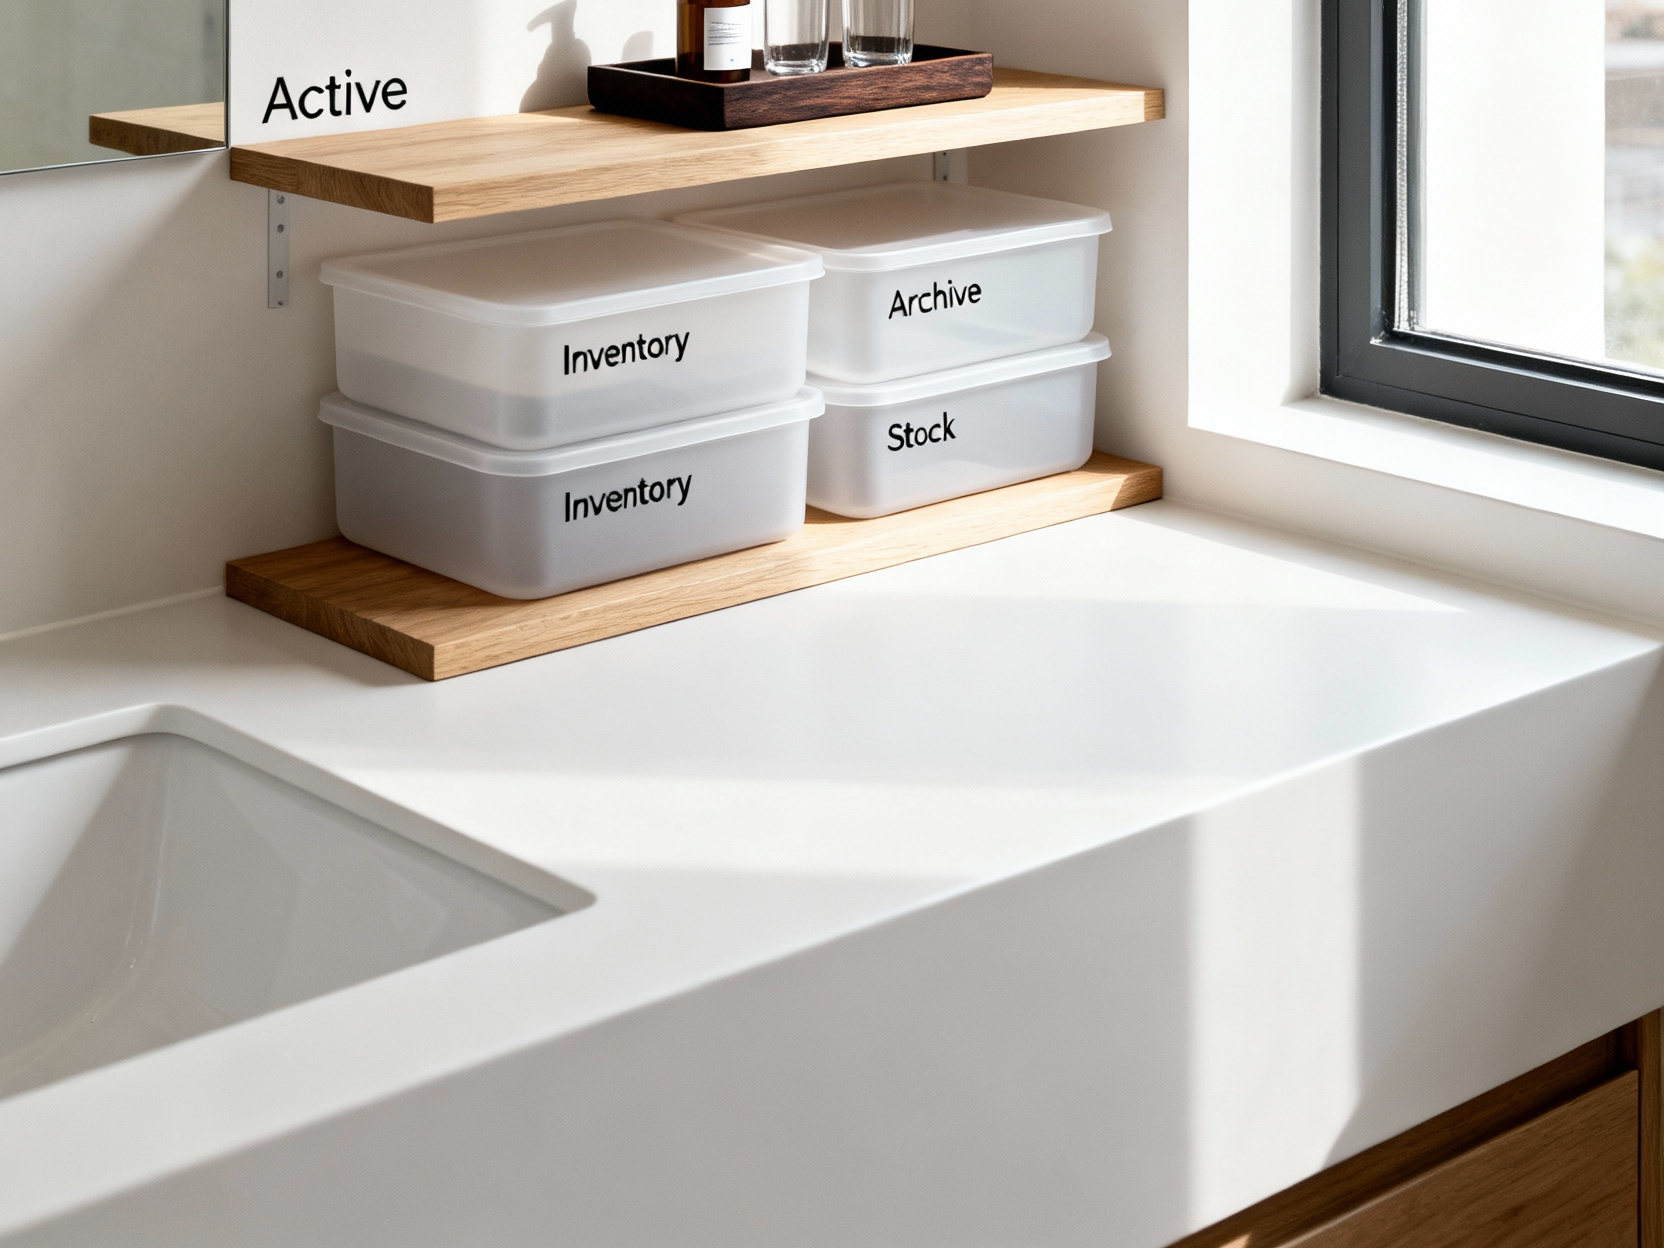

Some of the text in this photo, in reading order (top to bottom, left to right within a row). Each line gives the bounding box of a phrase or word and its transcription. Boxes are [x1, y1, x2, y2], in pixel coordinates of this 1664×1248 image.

[261, 68, 408, 124] Active
[888, 279, 982, 320] Archive
[563, 331, 690, 376] Inventory
[887, 411, 957, 452] Stock
[564, 474, 693, 523] Inventory
